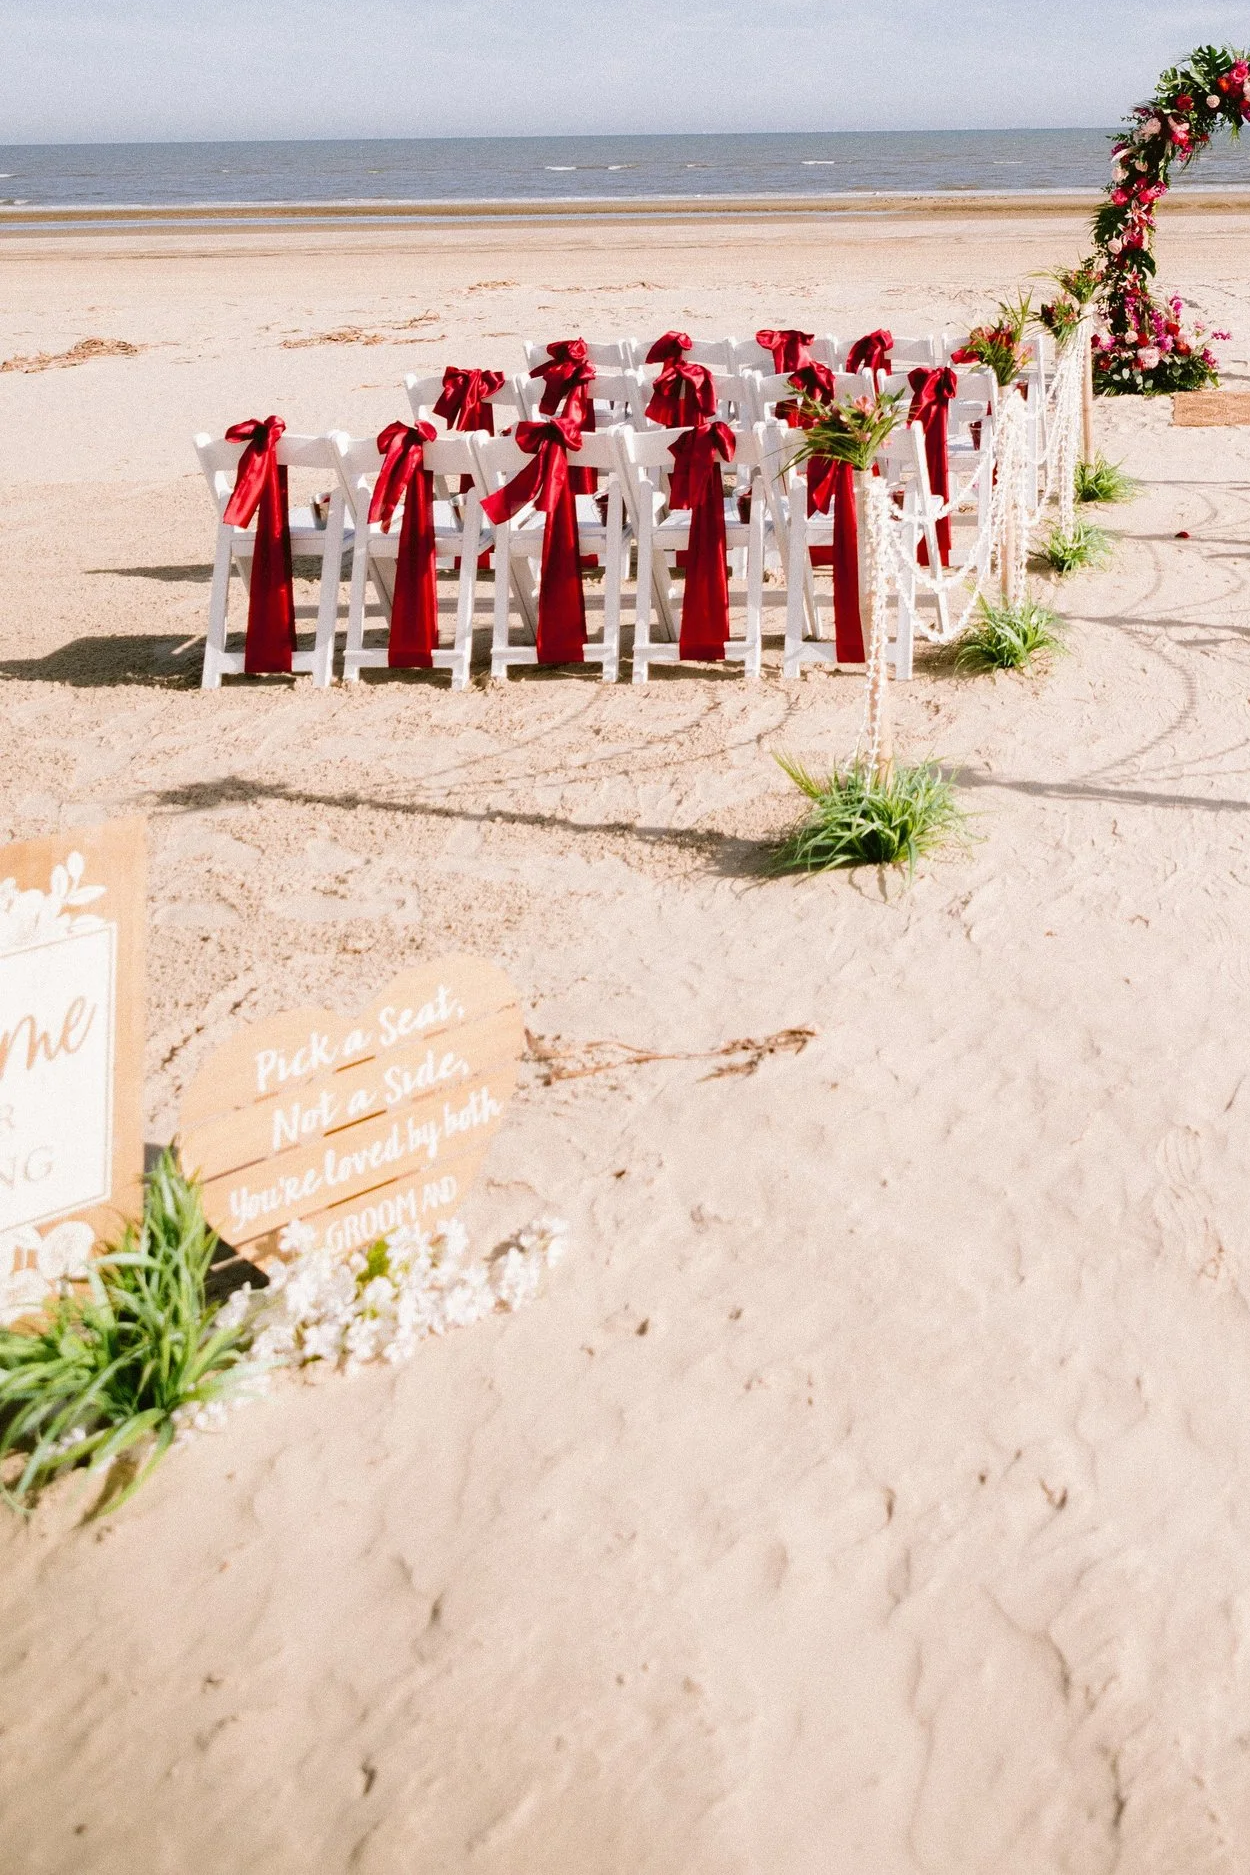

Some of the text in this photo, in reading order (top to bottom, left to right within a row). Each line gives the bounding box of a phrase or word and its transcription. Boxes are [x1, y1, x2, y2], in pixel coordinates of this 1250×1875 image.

[257, 1032, 338, 1092] Pick
[345, 1031, 373, 1056] a
[273, 1092, 341, 1149] Not
[349, 1090, 375, 1115] a
[325, 1126, 405, 1185] loved
[408, 1118, 438, 1158] by
[444, 1088, 502, 1137] both
[326, 1191, 417, 1250] GROOM
